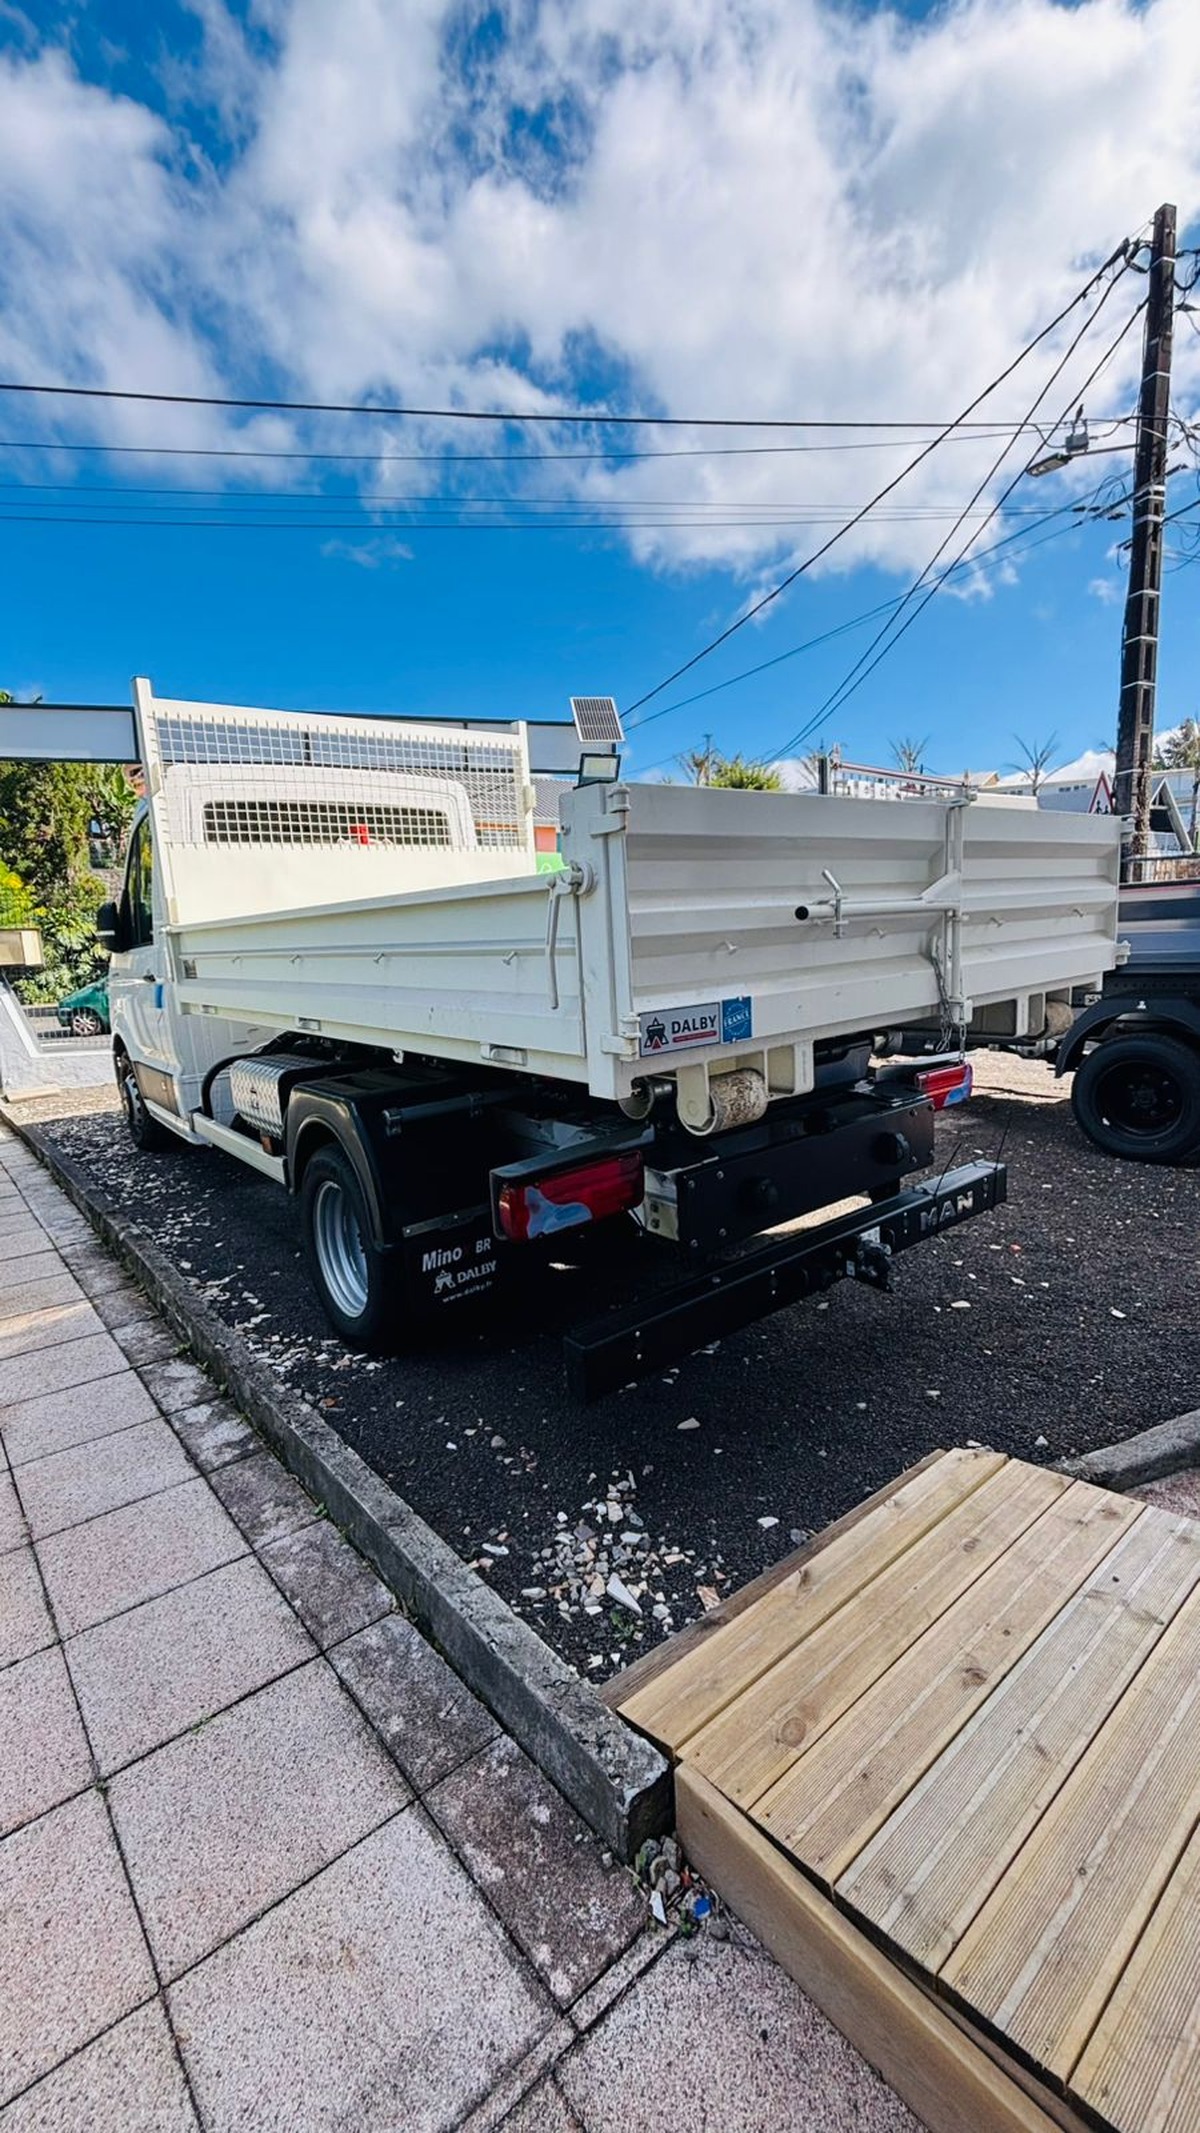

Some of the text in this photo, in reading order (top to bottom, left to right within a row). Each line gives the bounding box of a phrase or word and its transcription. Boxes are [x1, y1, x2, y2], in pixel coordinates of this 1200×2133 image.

[671, 1015, 717, 1034] DALBY
[920, 1190, 974, 1231] MAN
[422, 1238, 492, 1273] Mino BR
[457, 1260, 497, 1283] DALBY
